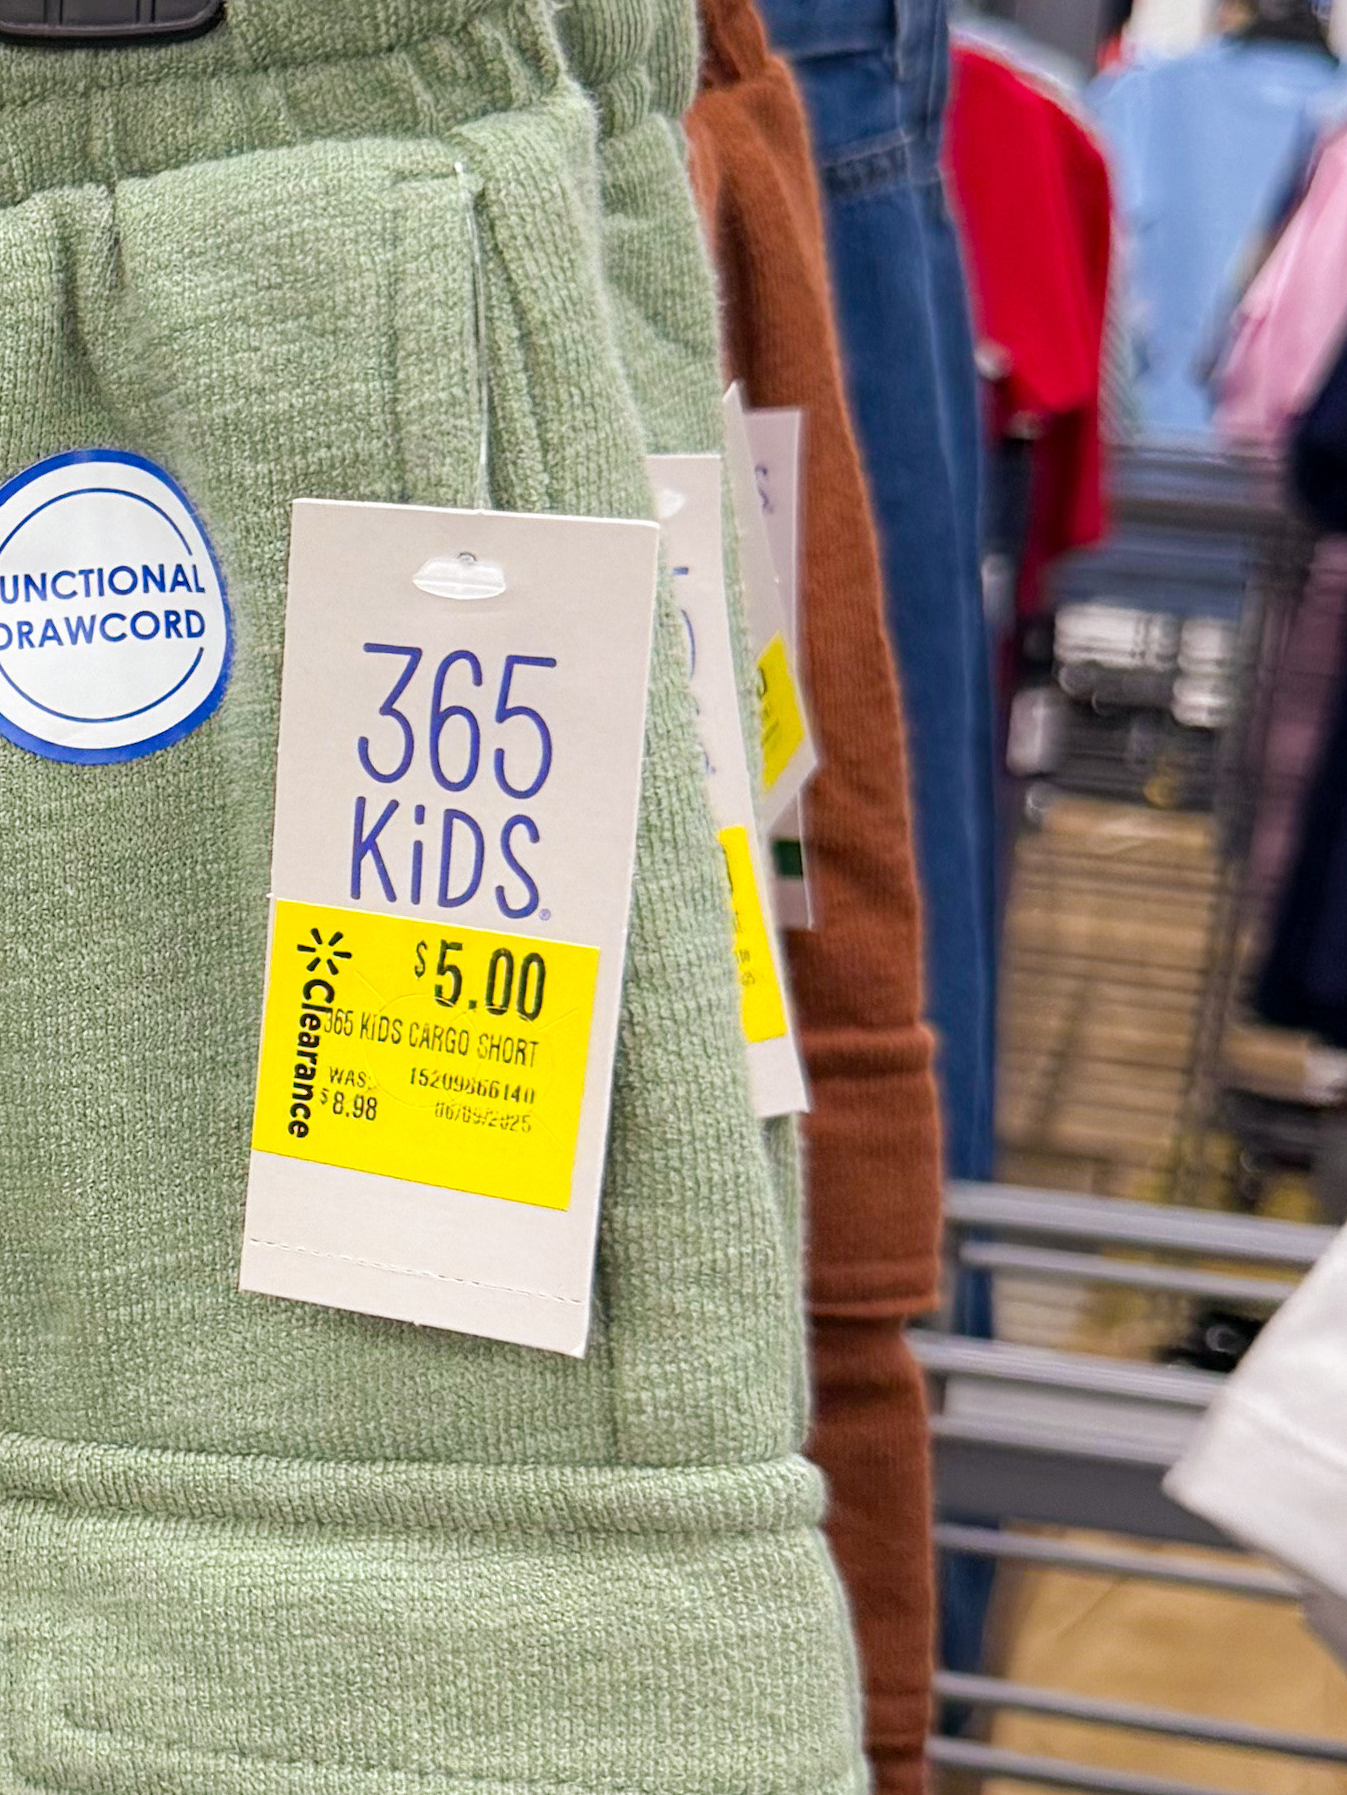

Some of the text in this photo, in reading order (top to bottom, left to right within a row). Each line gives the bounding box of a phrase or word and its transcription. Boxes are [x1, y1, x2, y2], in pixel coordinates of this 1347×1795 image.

[357, 641, 558, 799] 365
[413, 939, 547, 1022] $5.00
[287, 977, 336, 1139] Clearance
[323, 1008, 540, 1068] 365 KIDS CARGO SHORT
[319, 1087, 378, 1122] $8.98
